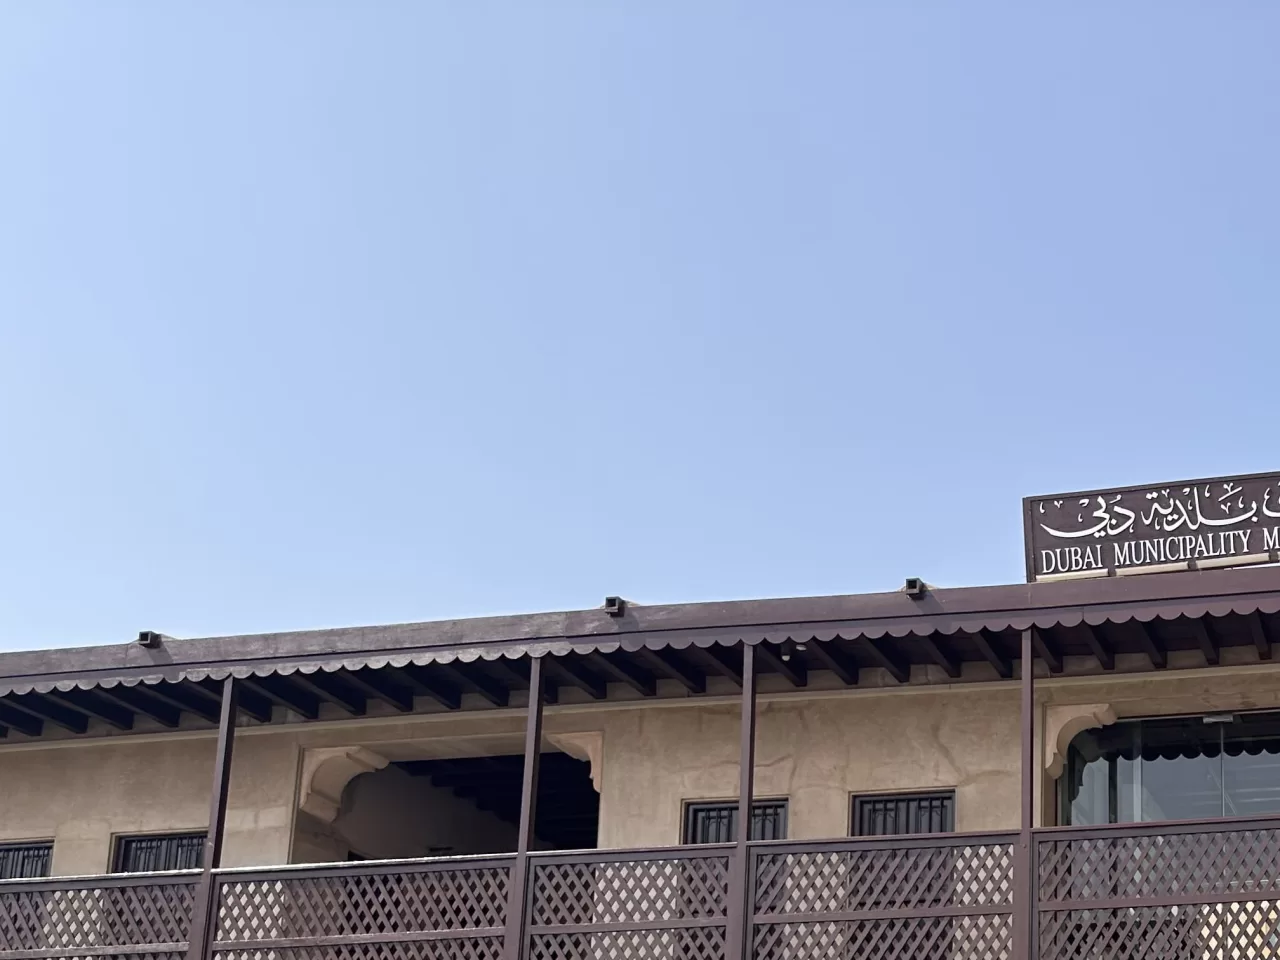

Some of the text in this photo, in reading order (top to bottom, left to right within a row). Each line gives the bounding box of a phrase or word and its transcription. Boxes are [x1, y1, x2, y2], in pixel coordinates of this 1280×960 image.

[1040, 495, 1135, 538] دبي
[1140, 482, 1258, 532] بلدية
[1041, 545, 1103, 573] DUBAI
[1113, 529, 1252, 567] MUNICIPALITY
